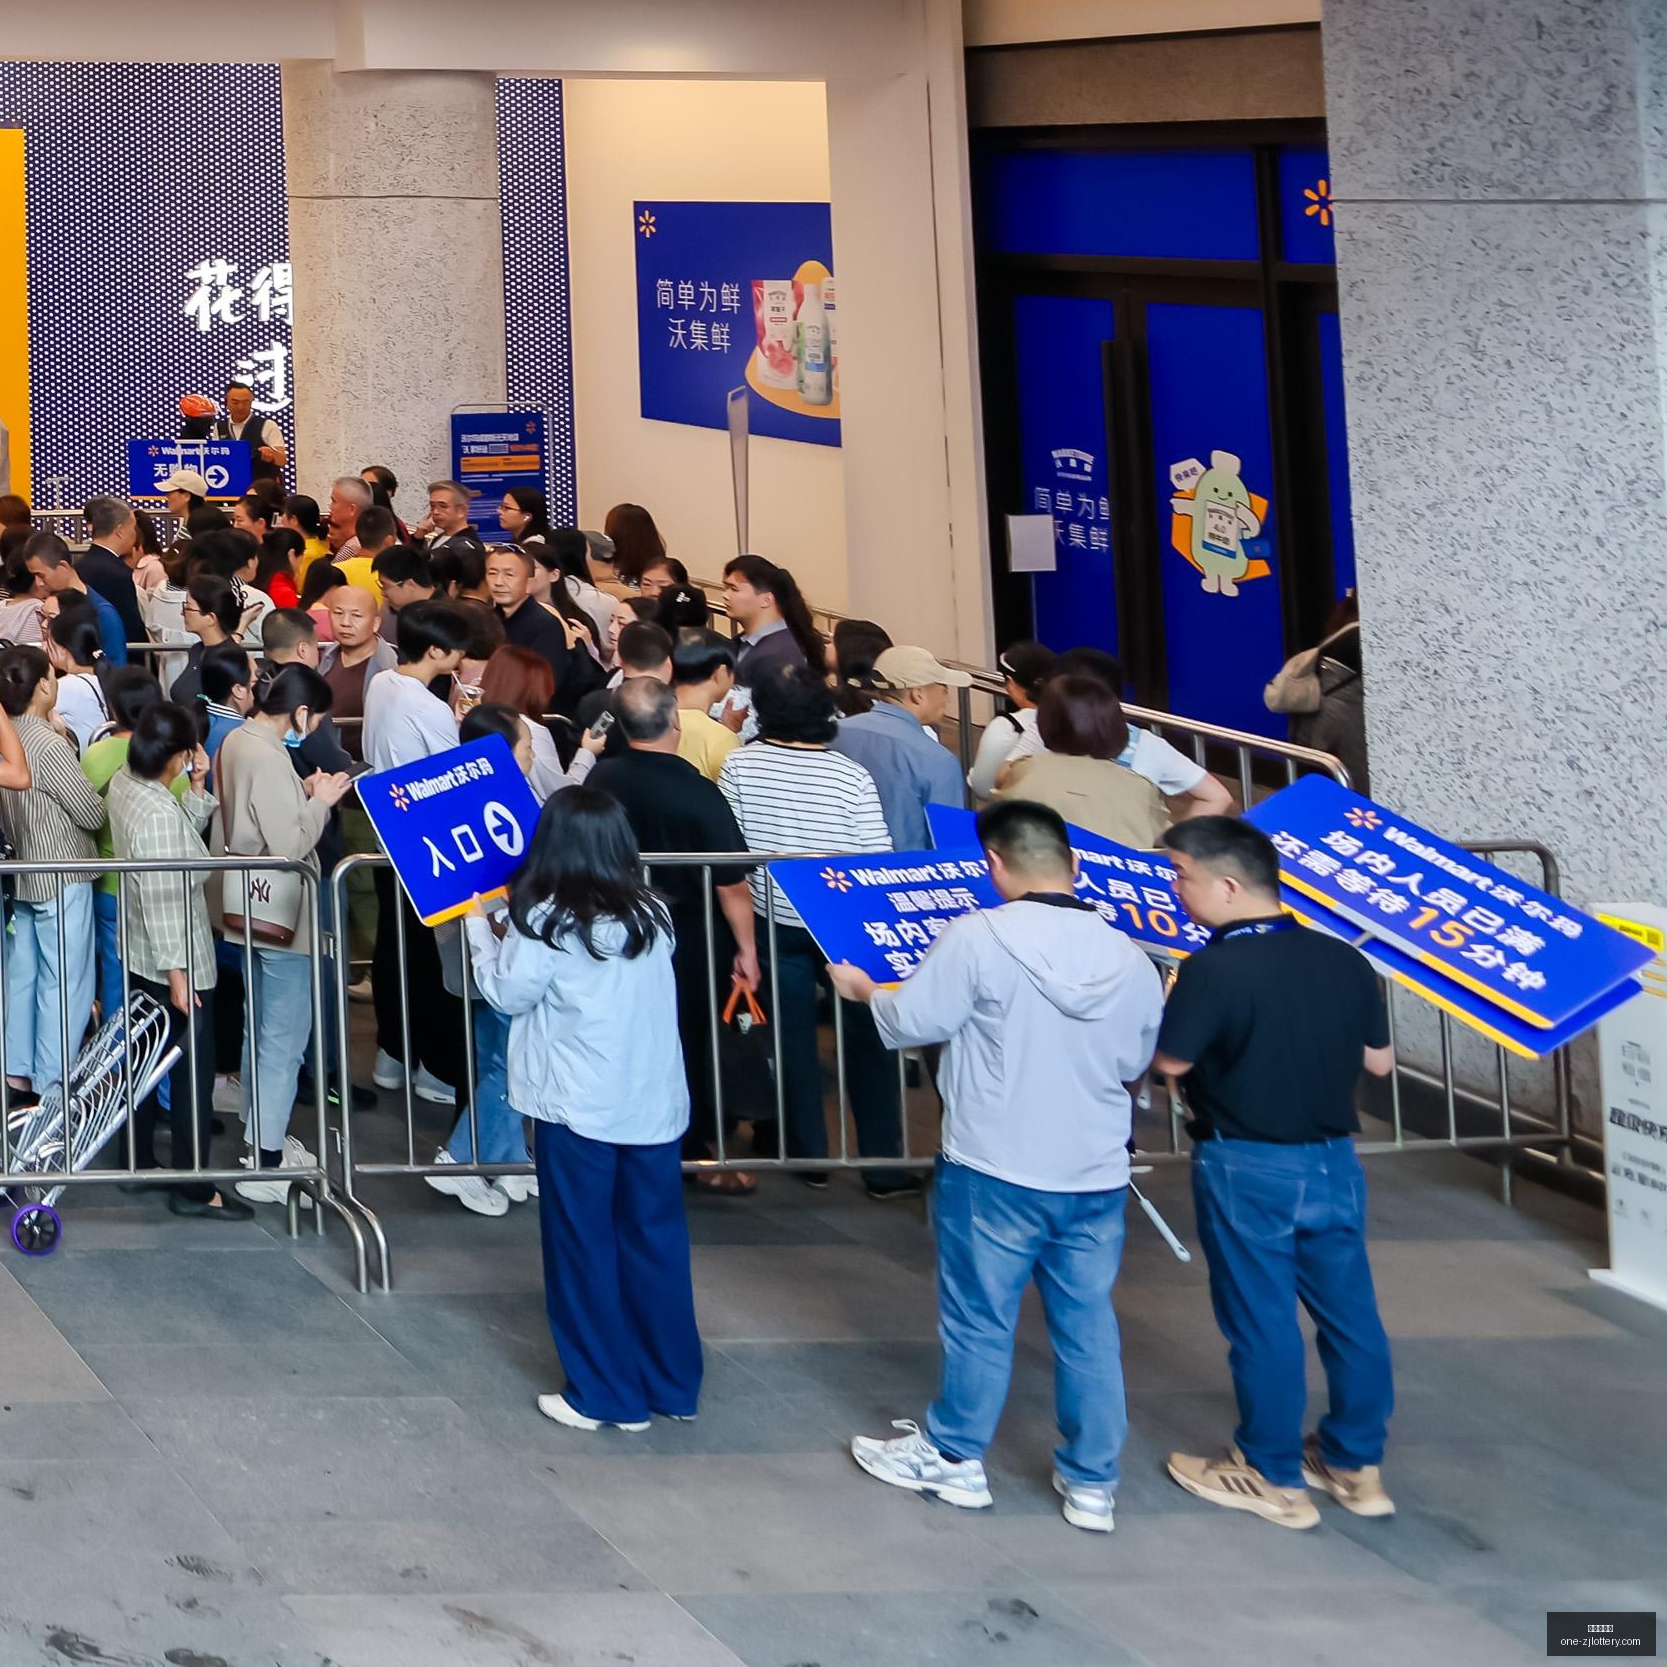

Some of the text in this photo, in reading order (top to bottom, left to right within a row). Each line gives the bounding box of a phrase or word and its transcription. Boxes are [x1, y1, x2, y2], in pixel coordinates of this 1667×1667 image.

[656, 278, 741, 314] 简单为鲜
[668, 317, 731, 354] 沃集鲜
[405, 757, 495, 802] Walmart 沃尔玛
[422, 823, 485, 878] 入口
[849, 859, 989, 887] Walmart 沃尔
[885, 887, 981, 914] 温馨提示
[1073, 871, 1187, 916] 人员已
[1319, 829, 1547, 958] 场内人员已满
[1381, 825, 1584, 940] Walmart 沃尔玛
[1269, 830, 1548, 992] 还需等待15分钟
